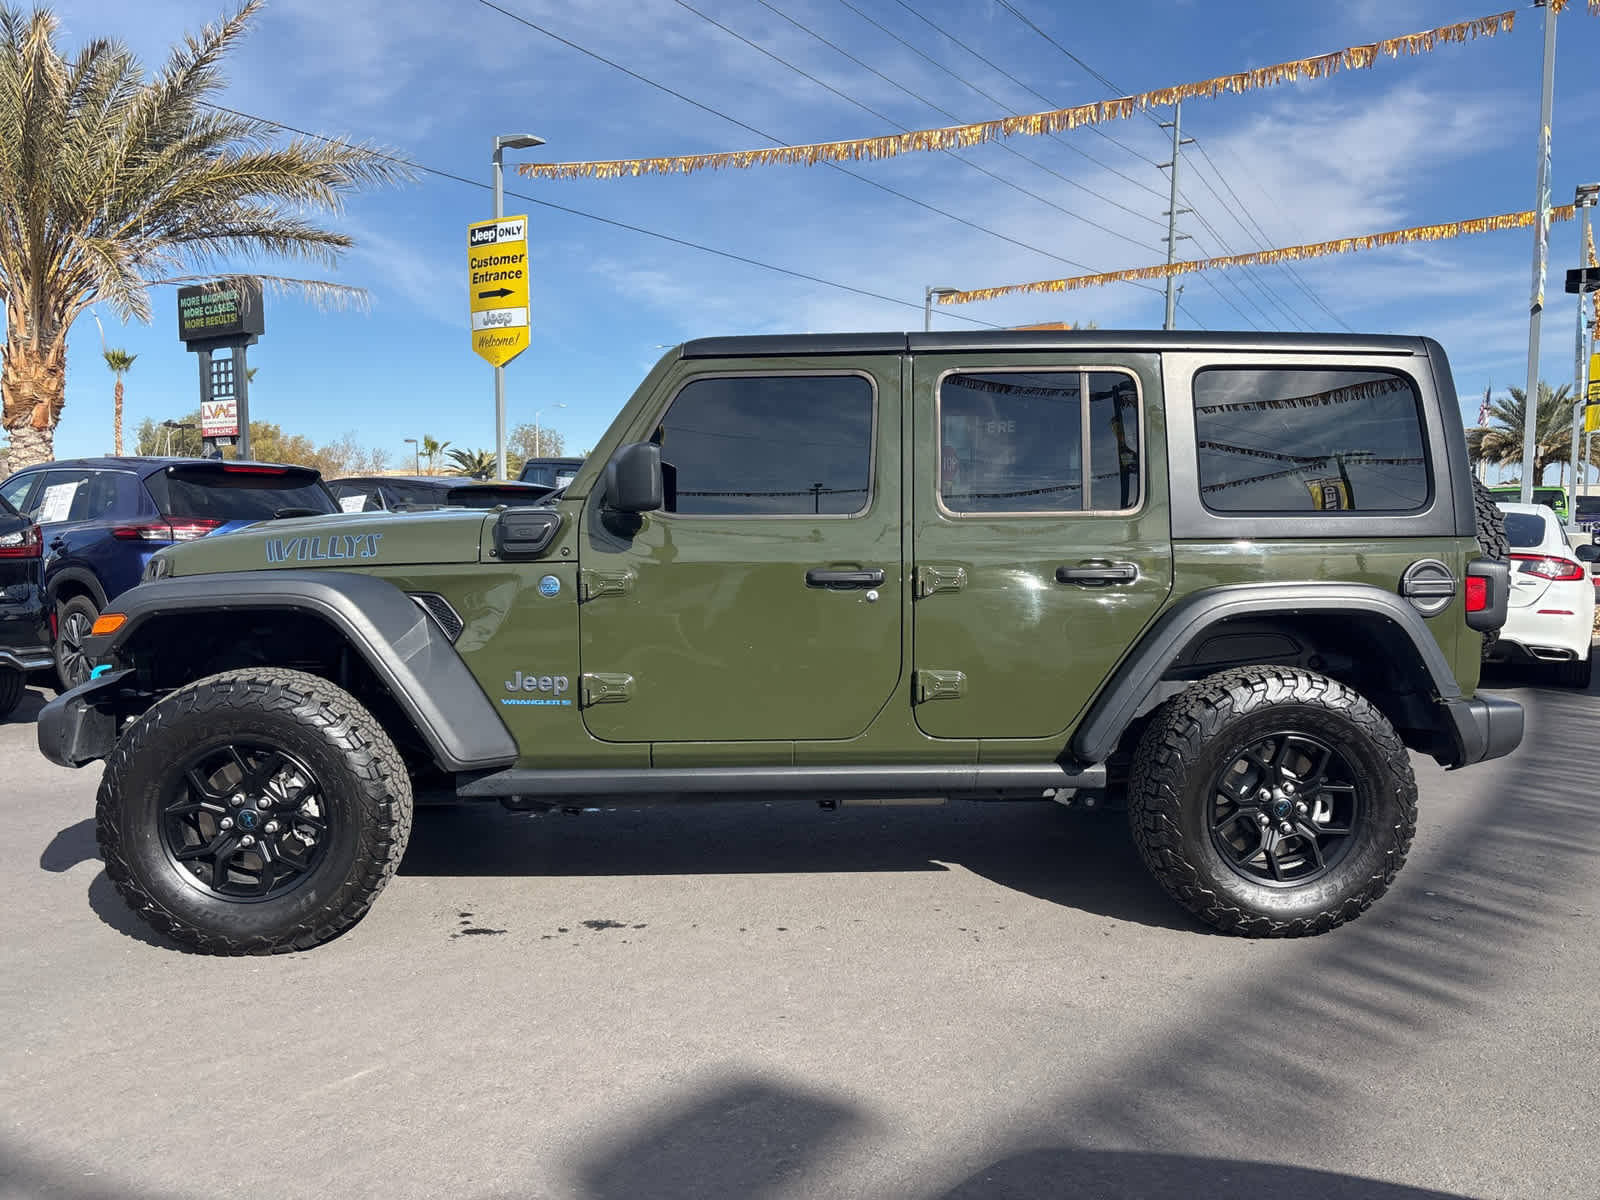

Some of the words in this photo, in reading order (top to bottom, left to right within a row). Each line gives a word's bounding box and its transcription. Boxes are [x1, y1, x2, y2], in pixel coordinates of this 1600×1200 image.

[471, 228, 496, 243] Jeep
[498, 225, 522, 238] ONLY
[470, 253, 525, 269] Customer
[472, 269, 522, 285] Entrance
[180, 295, 201, 307] MORE
[183, 307, 204, 318] MORE
[482, 311, 513, 327] Jeep
[184, 318, 205, 329] MORE
[478, 332, 521, 349] Welcome!
[265, 533, 384, 563] WILLYS
[503, 671, 569, 697] Jeep
